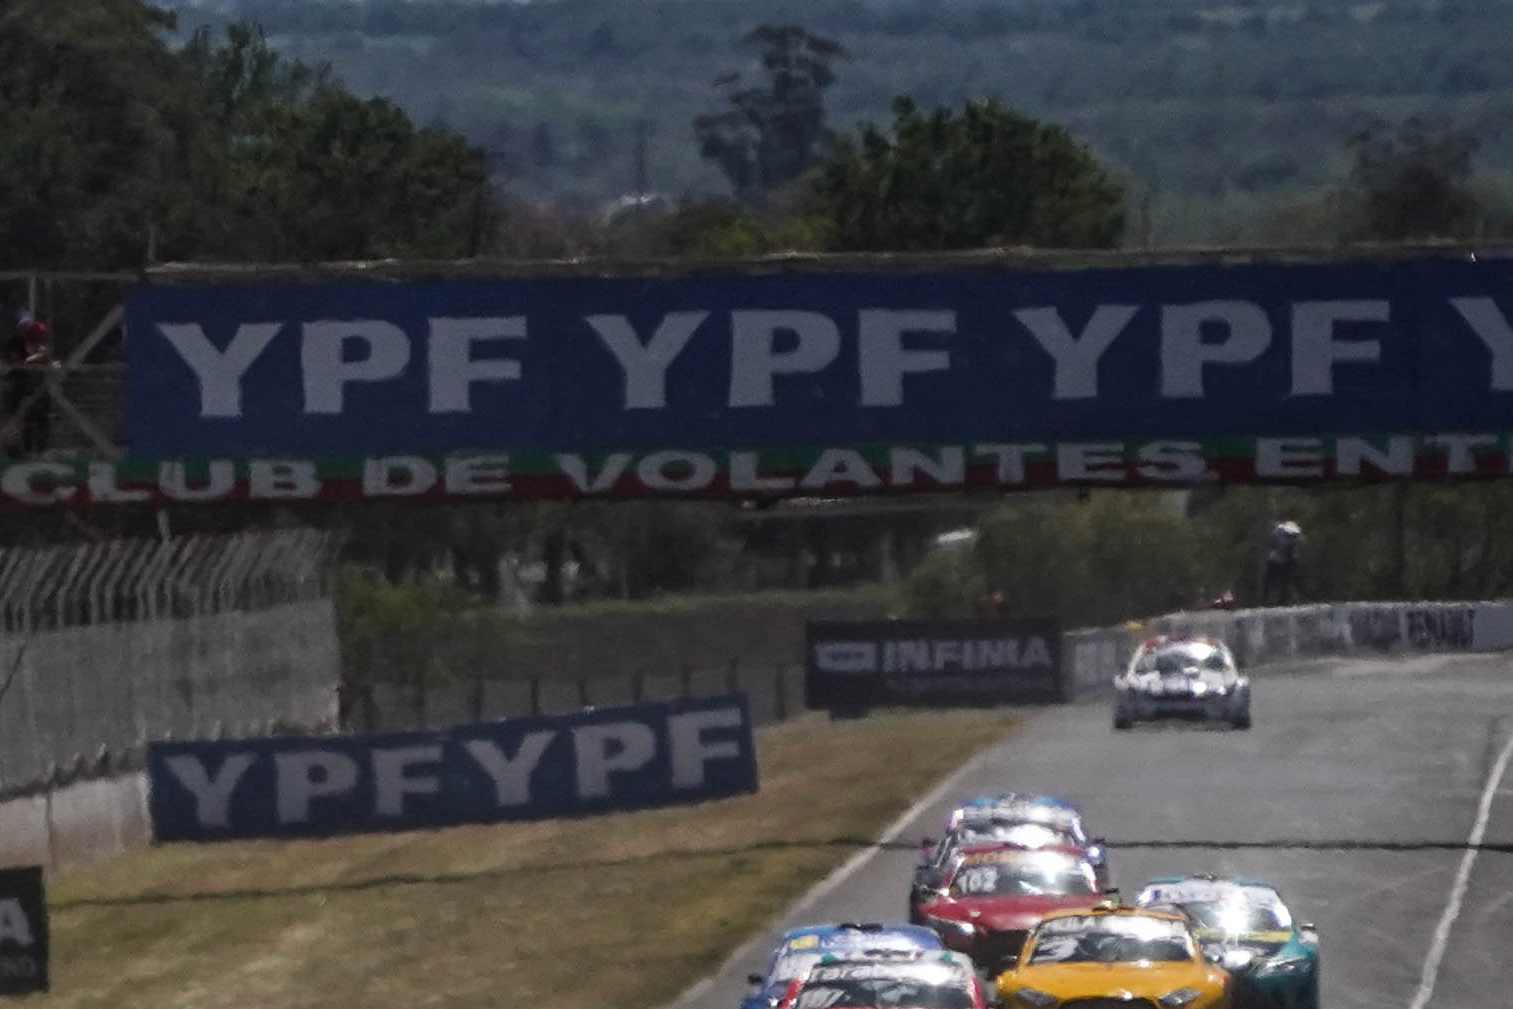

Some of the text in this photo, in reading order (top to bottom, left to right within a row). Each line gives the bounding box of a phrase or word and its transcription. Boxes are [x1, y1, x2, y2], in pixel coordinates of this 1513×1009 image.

[155, 315, 527, 418] YPF
[584, 308, 957, 410] YPF
[1010, 299, 1390, 400] YPF
[0, 433, 1513, 504] CLUB DE VOLANTES ENT
[882, 635, 1053, 672] INFINIA
[164, 706, 744, 828] YPF YPF
